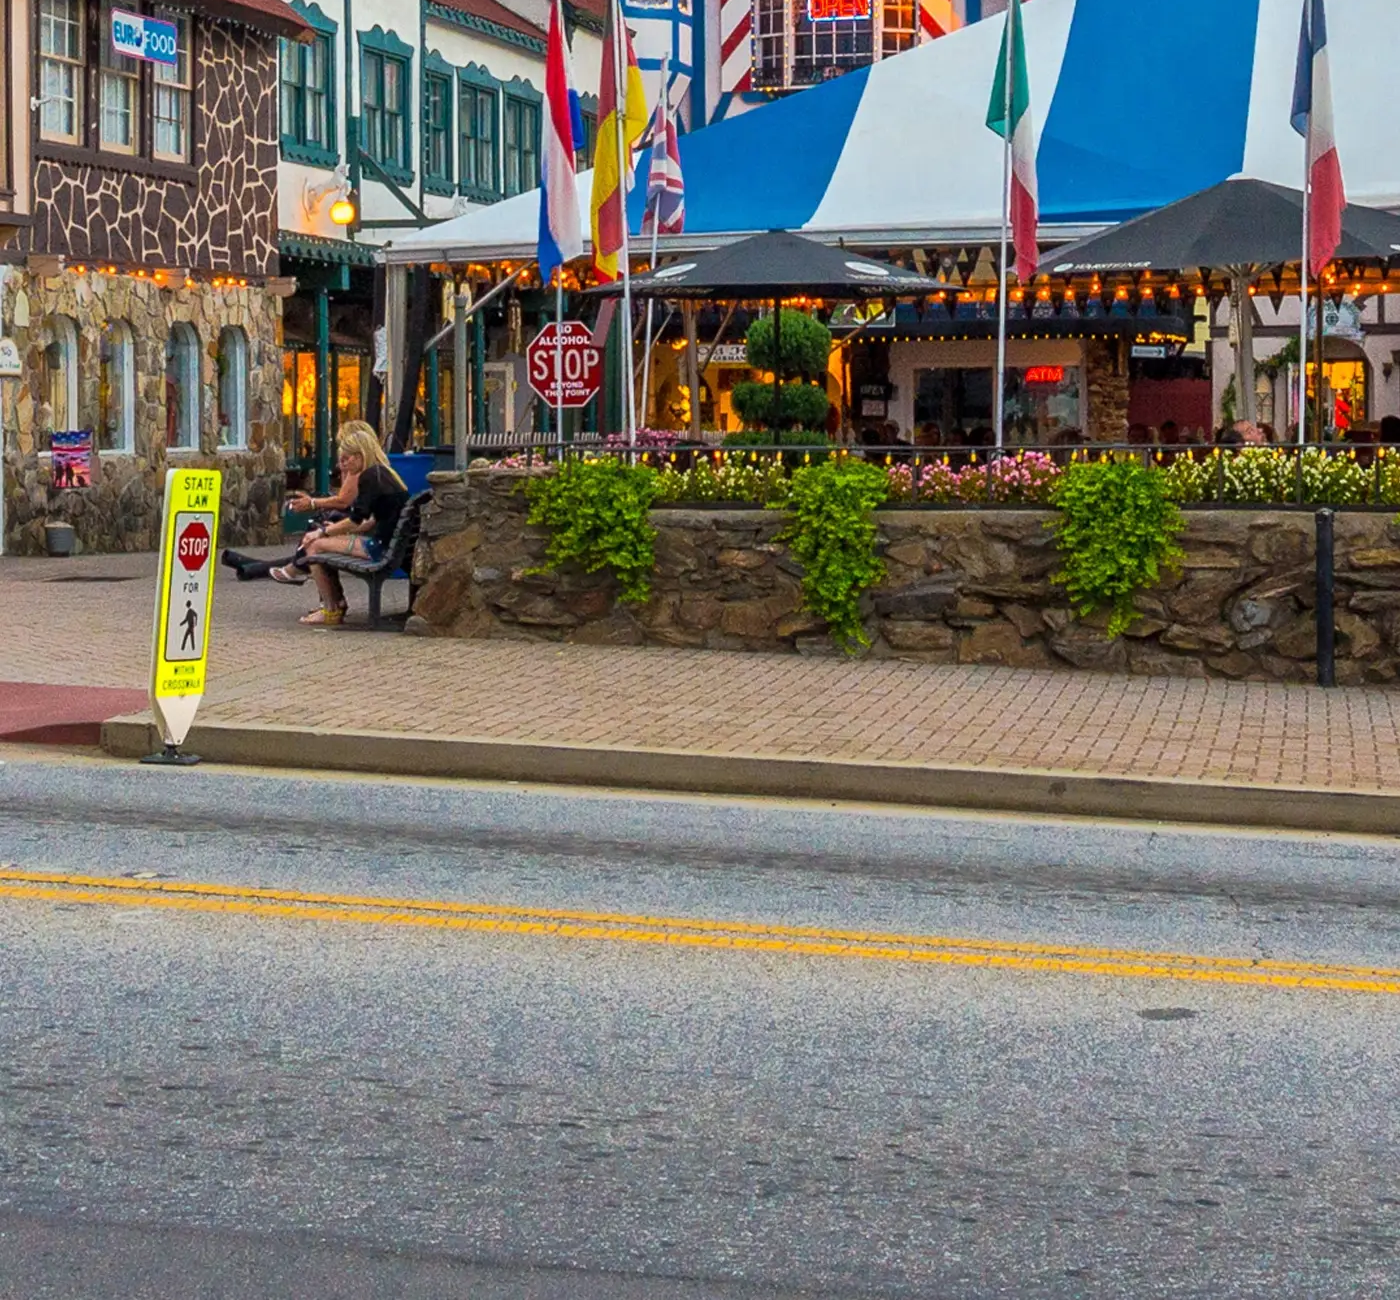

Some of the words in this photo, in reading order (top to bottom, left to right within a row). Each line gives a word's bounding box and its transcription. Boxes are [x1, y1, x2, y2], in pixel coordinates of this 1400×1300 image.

[143, 30, 177, 55] FOOD
[539, 335, 590, 345] ALCOHOL
[533, 349, 599, 380] STOP
[1026, 367, 1063, 381] ATM
[184, 476, 215, 491] STATE
[187, 494, 209, 508] LAW
[179, 537, 208, 556] STOP
[183, 582, 199, 593] FOR
[162, 679, 201, 691] CROSSWALK
